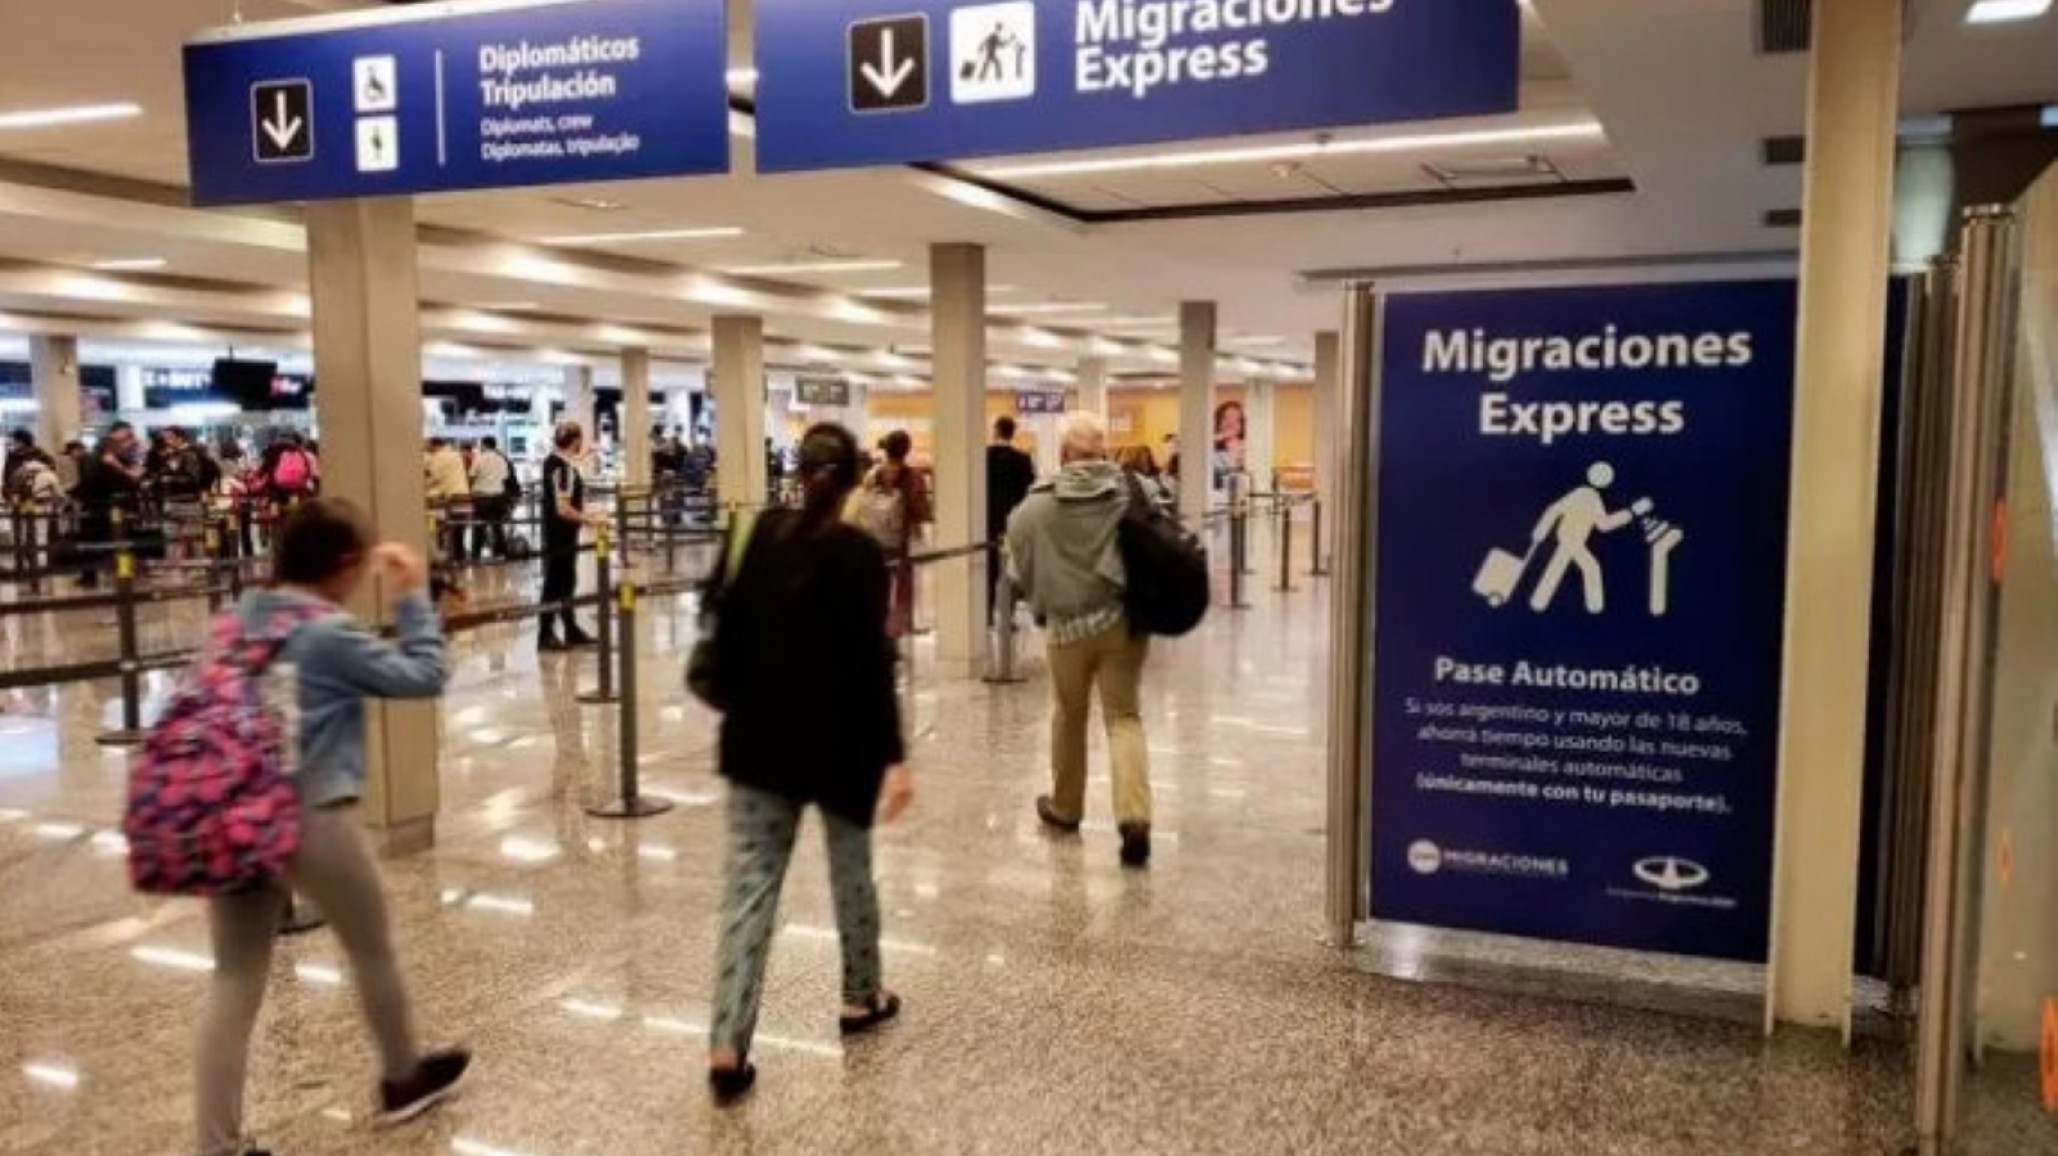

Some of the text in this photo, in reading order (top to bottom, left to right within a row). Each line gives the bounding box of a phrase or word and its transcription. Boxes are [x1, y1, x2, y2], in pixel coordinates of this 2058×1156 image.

[480, 36, 639, 74] Diplomáticos
[1075, 39, 1268, 98] Express
[480, 71, 616, 110] Tripulación
[1423, 324, 1752, 381] Migraciones
[1479, 393, 1684, 444] Express
[1434, 656, 1699, 695] Pase Automático
[1459, 703, 1549, 721] argentino
[1554, 712, 1566, 725] y
[1569, 711, 1630, 729] mayor
[1635, 713, 1661, 728] de
[1668, 713, 1690, 731] 18
[1695, 716, 1747, 735] años,
[1481, 729, 1549, 748] tiempo
[1554, 734, 1624, 752] usando
[1629, 736, 1654, 754] las
[1661, 742, 1732, 760] nuevas
[1460, 753, 1682, 782] terminales automáticas
[1416, 773, 1732, 813] (únicamente con tu pasaporte).
[1443, 851, 1569, 874] MIGRACIONES
